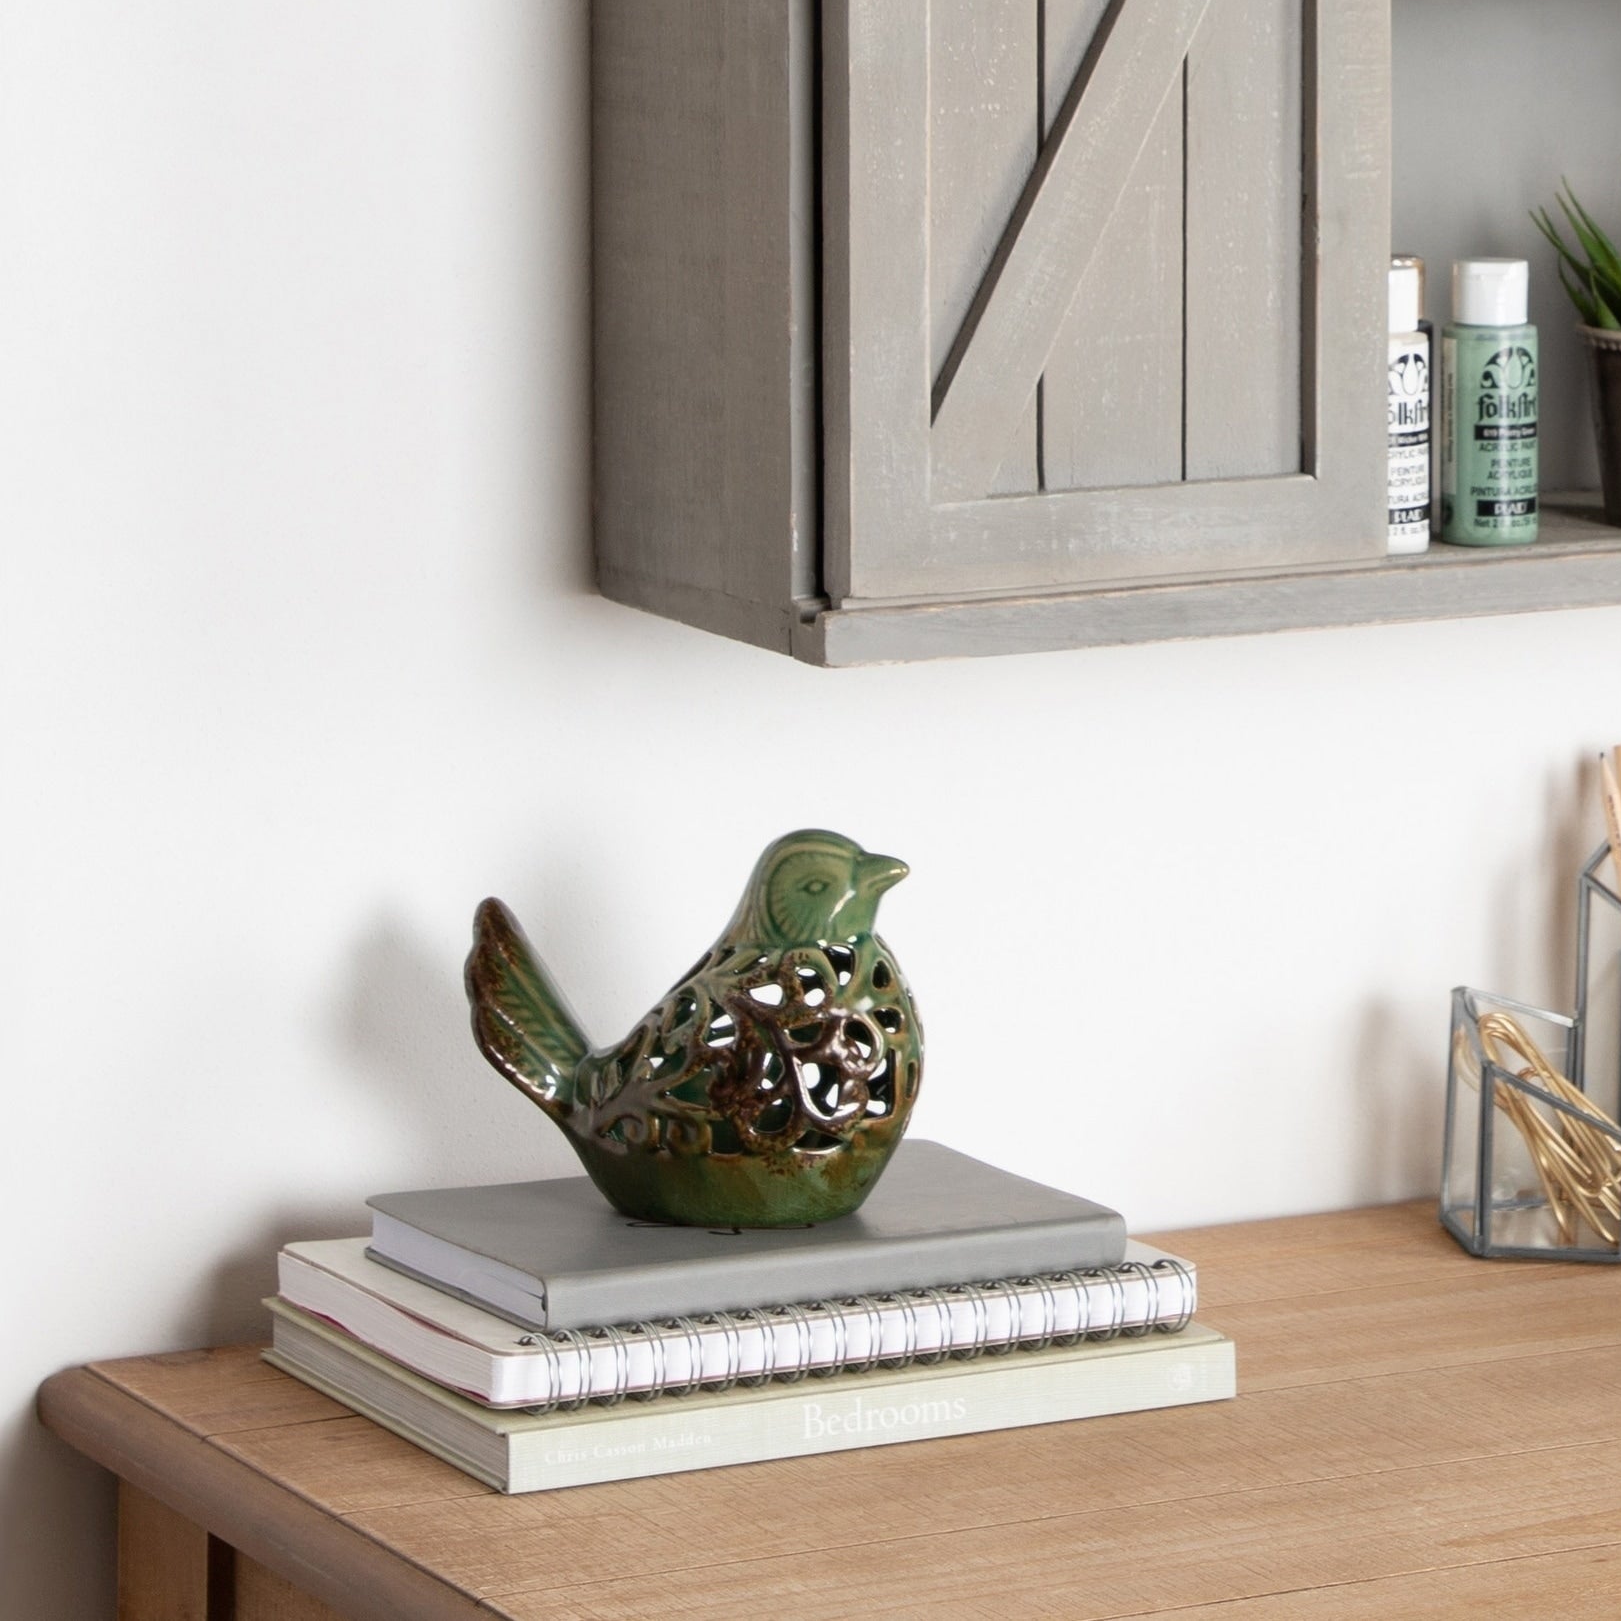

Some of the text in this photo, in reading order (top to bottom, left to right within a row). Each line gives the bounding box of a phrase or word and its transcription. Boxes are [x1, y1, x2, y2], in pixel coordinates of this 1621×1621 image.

[802, 1396, 967, 1440] Bedrooms
[544, 1432, 712, 1465] Chris Casson Madden
